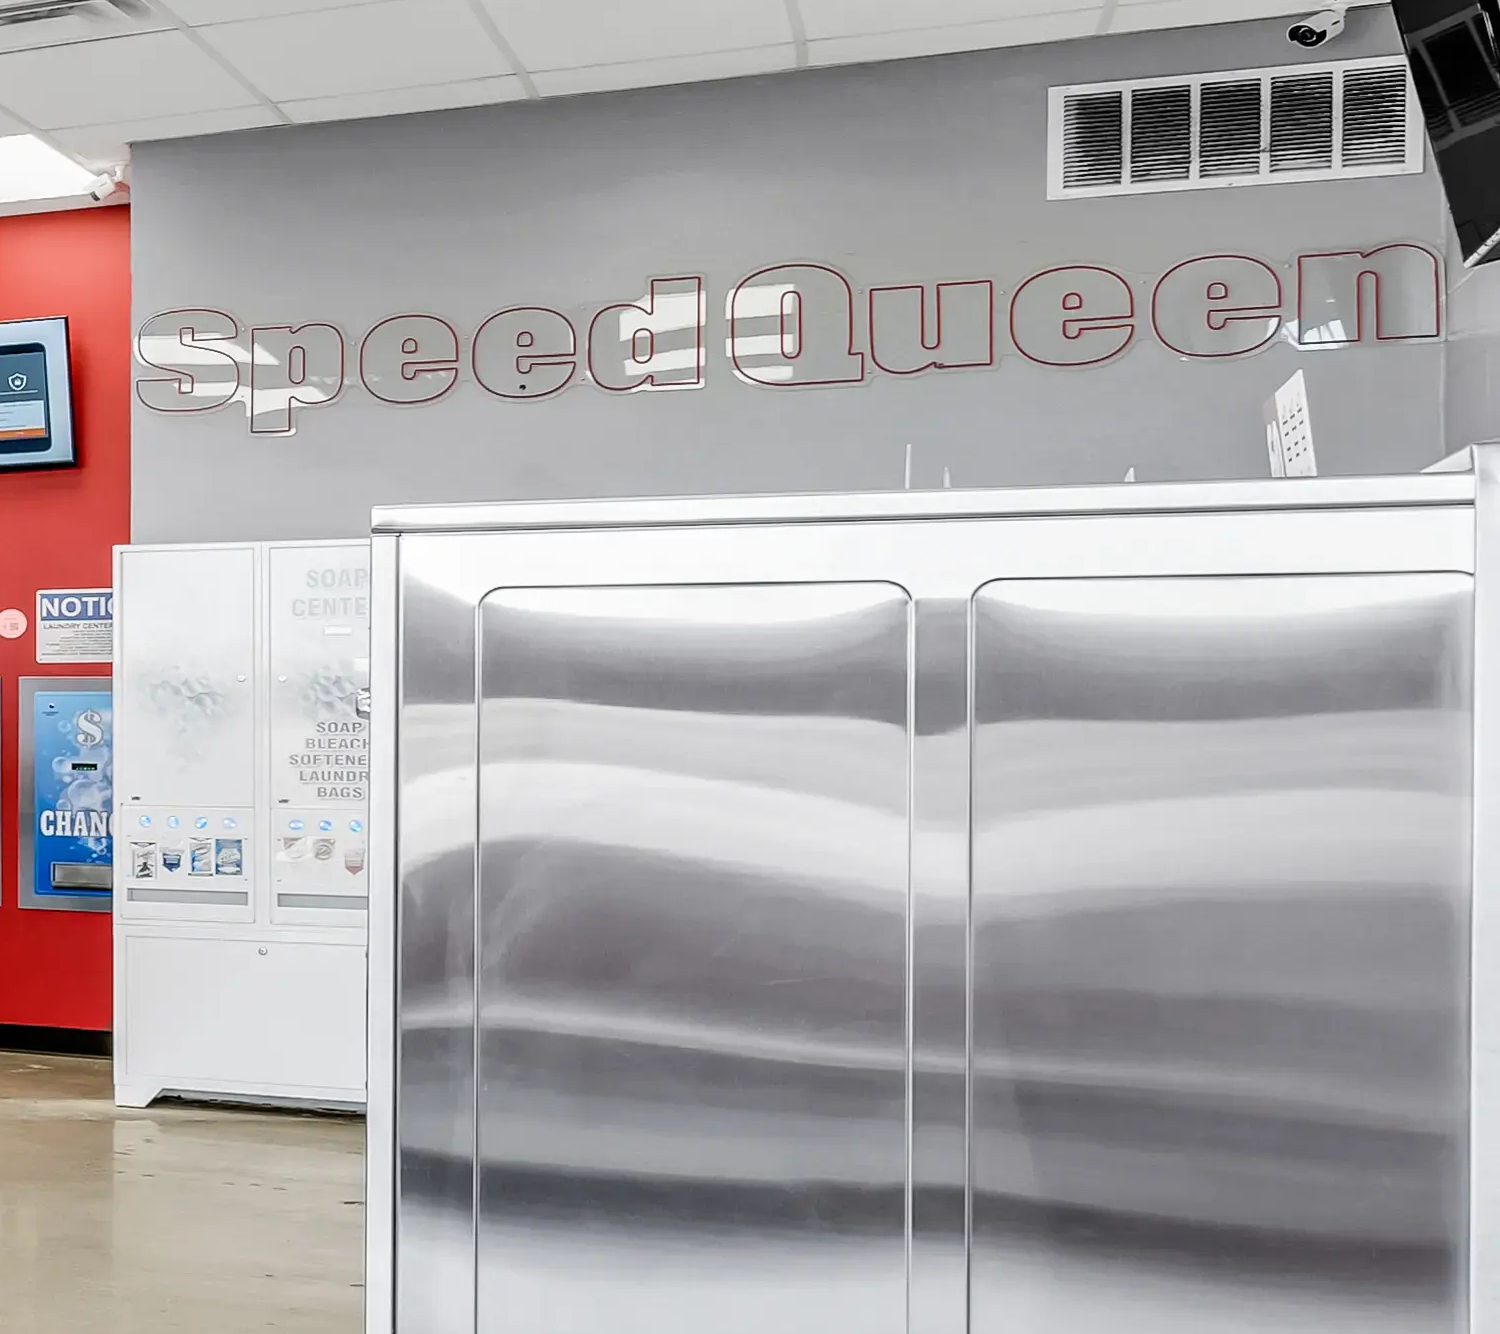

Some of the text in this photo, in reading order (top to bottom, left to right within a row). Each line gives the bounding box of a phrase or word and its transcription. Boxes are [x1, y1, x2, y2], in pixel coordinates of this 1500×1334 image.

[305, 568, 369, 589] SOAP
[41, 596, 113, 618] NOTI
[315, 721, 363, 733] SOAP
[316, 786, 363, 798] BAGS
[40, 809, 114, 837] CHAN
